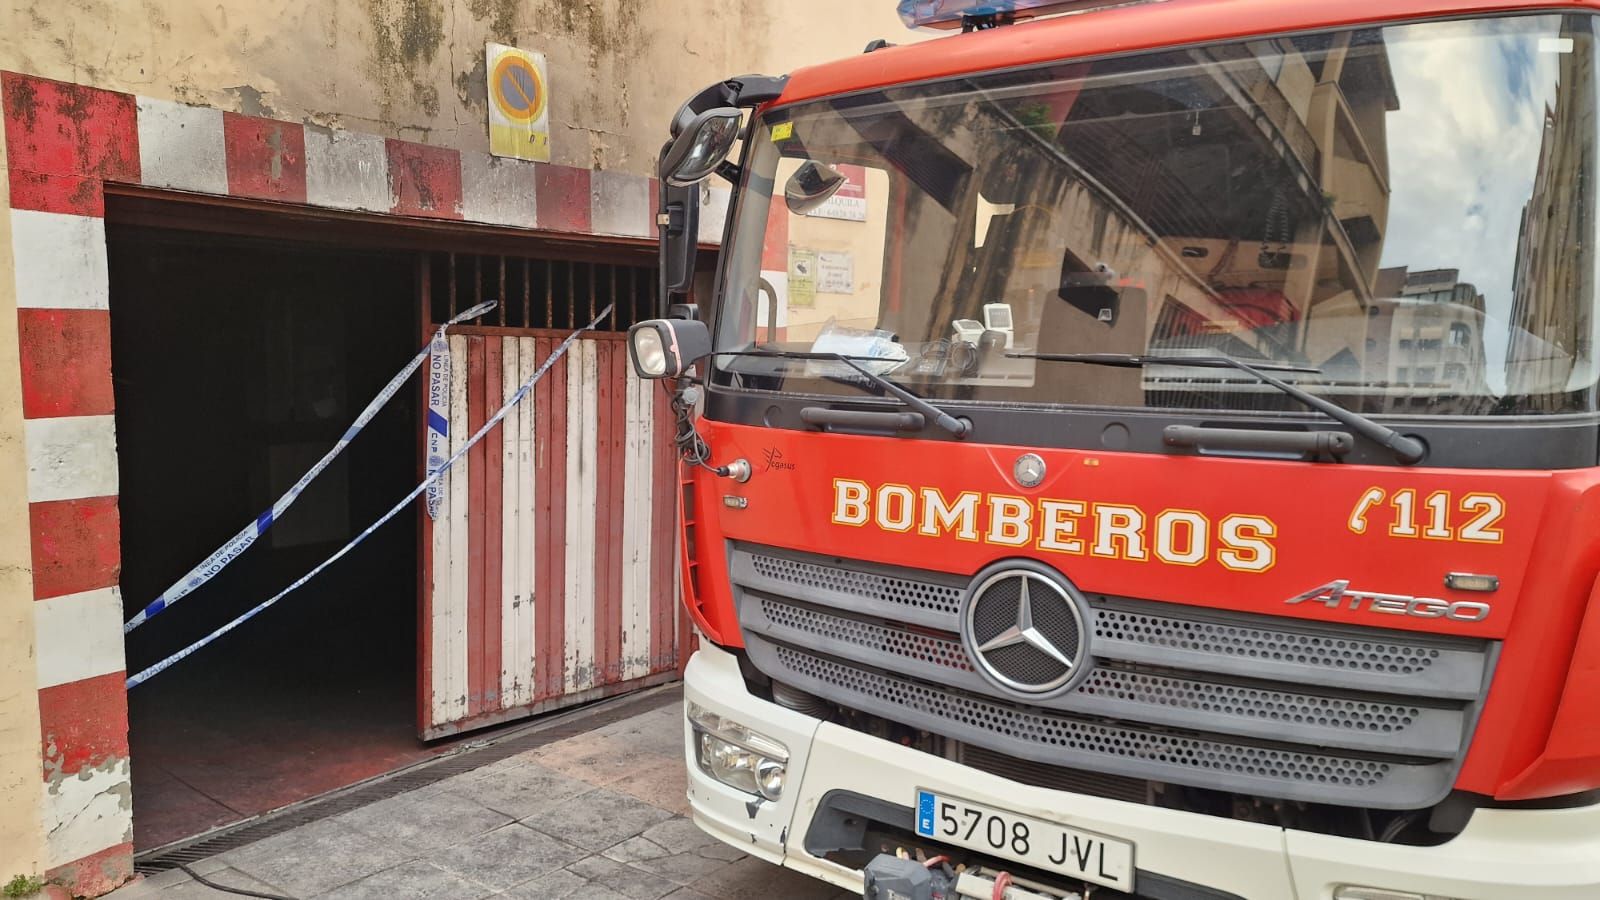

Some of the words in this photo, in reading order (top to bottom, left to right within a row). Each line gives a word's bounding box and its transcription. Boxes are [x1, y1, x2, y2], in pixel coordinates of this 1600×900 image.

[432, 354, 442, 370] NO
[431, 372, 441, 406] PASAR
[832, 477, 1278, 572] BOMBEROS
[1388, 488, 1506, 544] 112
[204, 564, 221, 578] NO
[221, 536, 255, 565] PASAR
[922, 818, 930, 829] E
[941, 803, 1030, 856] 5708
[1048, 832, 1119, 882] JVL
